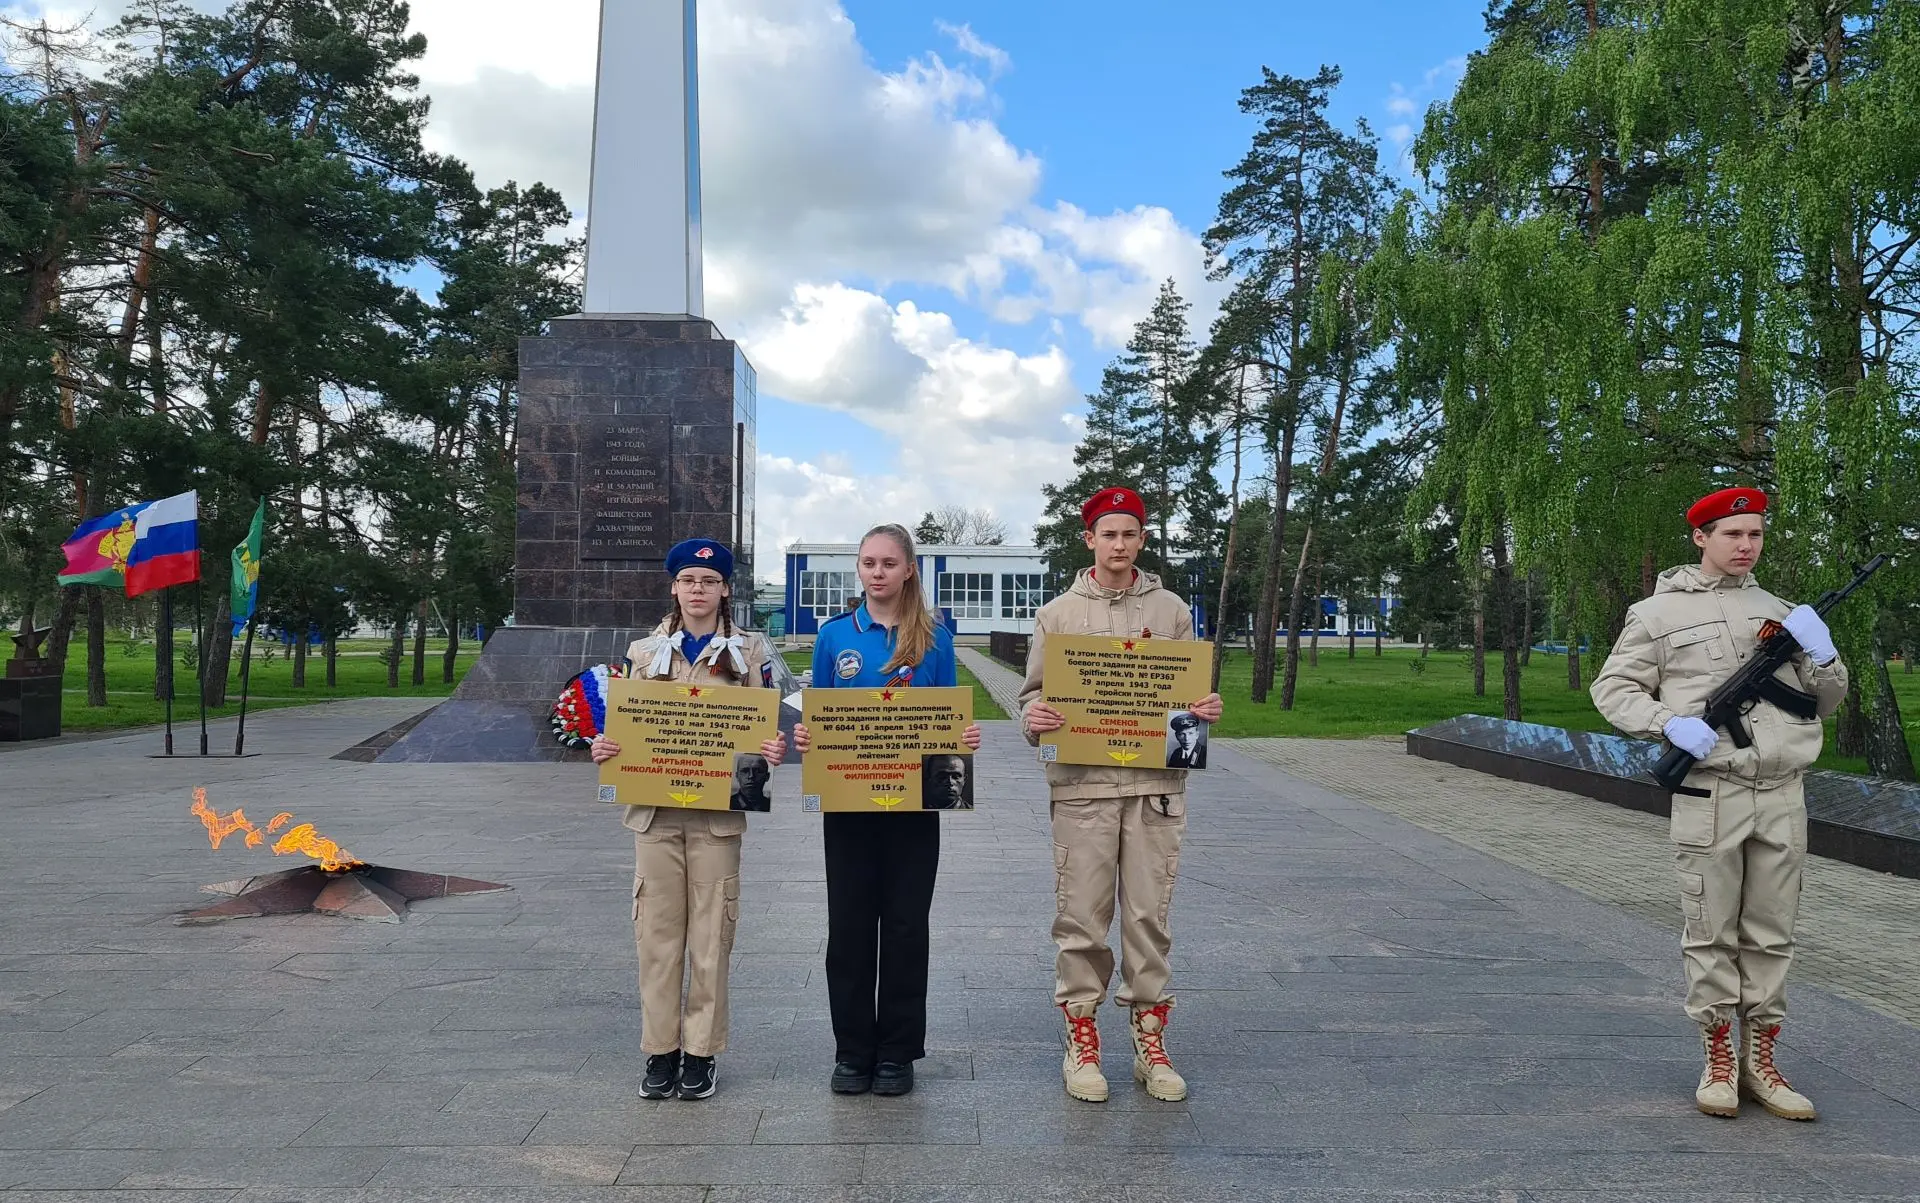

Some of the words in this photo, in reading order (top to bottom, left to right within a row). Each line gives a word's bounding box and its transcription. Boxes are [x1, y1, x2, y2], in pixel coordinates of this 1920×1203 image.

[1064, 649, 1075, 657] На
[1123, 653, 1139, 661] при
[1140, 654, 1192, 663] выполнении
[1067, 658, 1101, 667] боевого
[1101, 661, 1136, 670] задания
[1149, 664, 1188, 672] самолете
[1079, 668, 1109, 679] Spitfier
[1110, 670, 1135, 678] Mk.Vb
[1081, 678, 1092, 686] 29
[1095, 680, 1125, 689] апреля
[1129, 680, 1150, 689] 1943
[1153, 682, 1172, 691] года
[1094, 688, 1132, 698] геройски
[1133, 690, 1158, 699] погиб
[628, 697, 639, 705] На
[640, 699, 661, 707] этом
[662, 700, 688, 708] месте
[689, 702, 704, 710] при
[705, 703, 758, 712] выполнении
[1046, 696, 1087, 704] адъютант
[1087, 698, 1135, 707] эскадрильи
[1148, 700, 1170, 709] ГИАП
[1172, 702, 1186, 710] 216
[617, 705, 651, 715] боевого
[652, 708, 688, 718] задания
[701, 711, 740, 721] самолете
[742, 713, 767, 723] Як-16
[823, 705, 834, 713] На
[882, 706, 898, 714] при
[1086, 707, 1120, 716] гвардии
[1121, 709, 1164, 718] лейтенант
[644, 717, 670, 726] 49126
[674, 719, 685, 727] 10
[688, 720, 705, 728] мая
[709, 721, 730, 730] 1943
[731, 723, 751, 731] года
[811, 715, 844, 723] боевого
[845, 715, 880, 723] задания
[1099, 717, 1139, 727] СЕМЕНОВ
[658, 728, 697, 738] геройски
[698, 730, 723, 739] погиб
[835, 724, 855, 732] 6044
[932, 724, 952, 732] года
[1070, 726, 1120, 736] АЛЕКСАНДР
[1121, 728, 1167, 738] ИВАНОВИЧ
[645, 736, 670, 745] пилот
[679, 738, 697, 747] ИАП
[716, 740, 735, 750] ИАД
[855, 733, 894, 742] геройски
[895, 733, 920, 741] погиб
[817, 743, 858, 751] командир
[939, 742, 958, 751] ИАД
[1107, 739, 1127, 747] 1921
[1129, 741, 1143, 749] г.р.
[652, 746, 689, 755] старший
[690, 749, 725, 758] сержант
[856, 752, 901, 760] лейтенант
[651, 757, 704, 767] МАРТЬЯНОВ
[826, 763, 870, 771] ФИЛИПОВ
[871, 763, 922, 771] АЛЕКСАНДР
[620, 765, 664, 775] НИКОЛАЙ
[665, 767, 733, 779] КОНДРАТЬЕВИЧ
[844, 772, 905, 780] ФИЛИППОВИЧ
